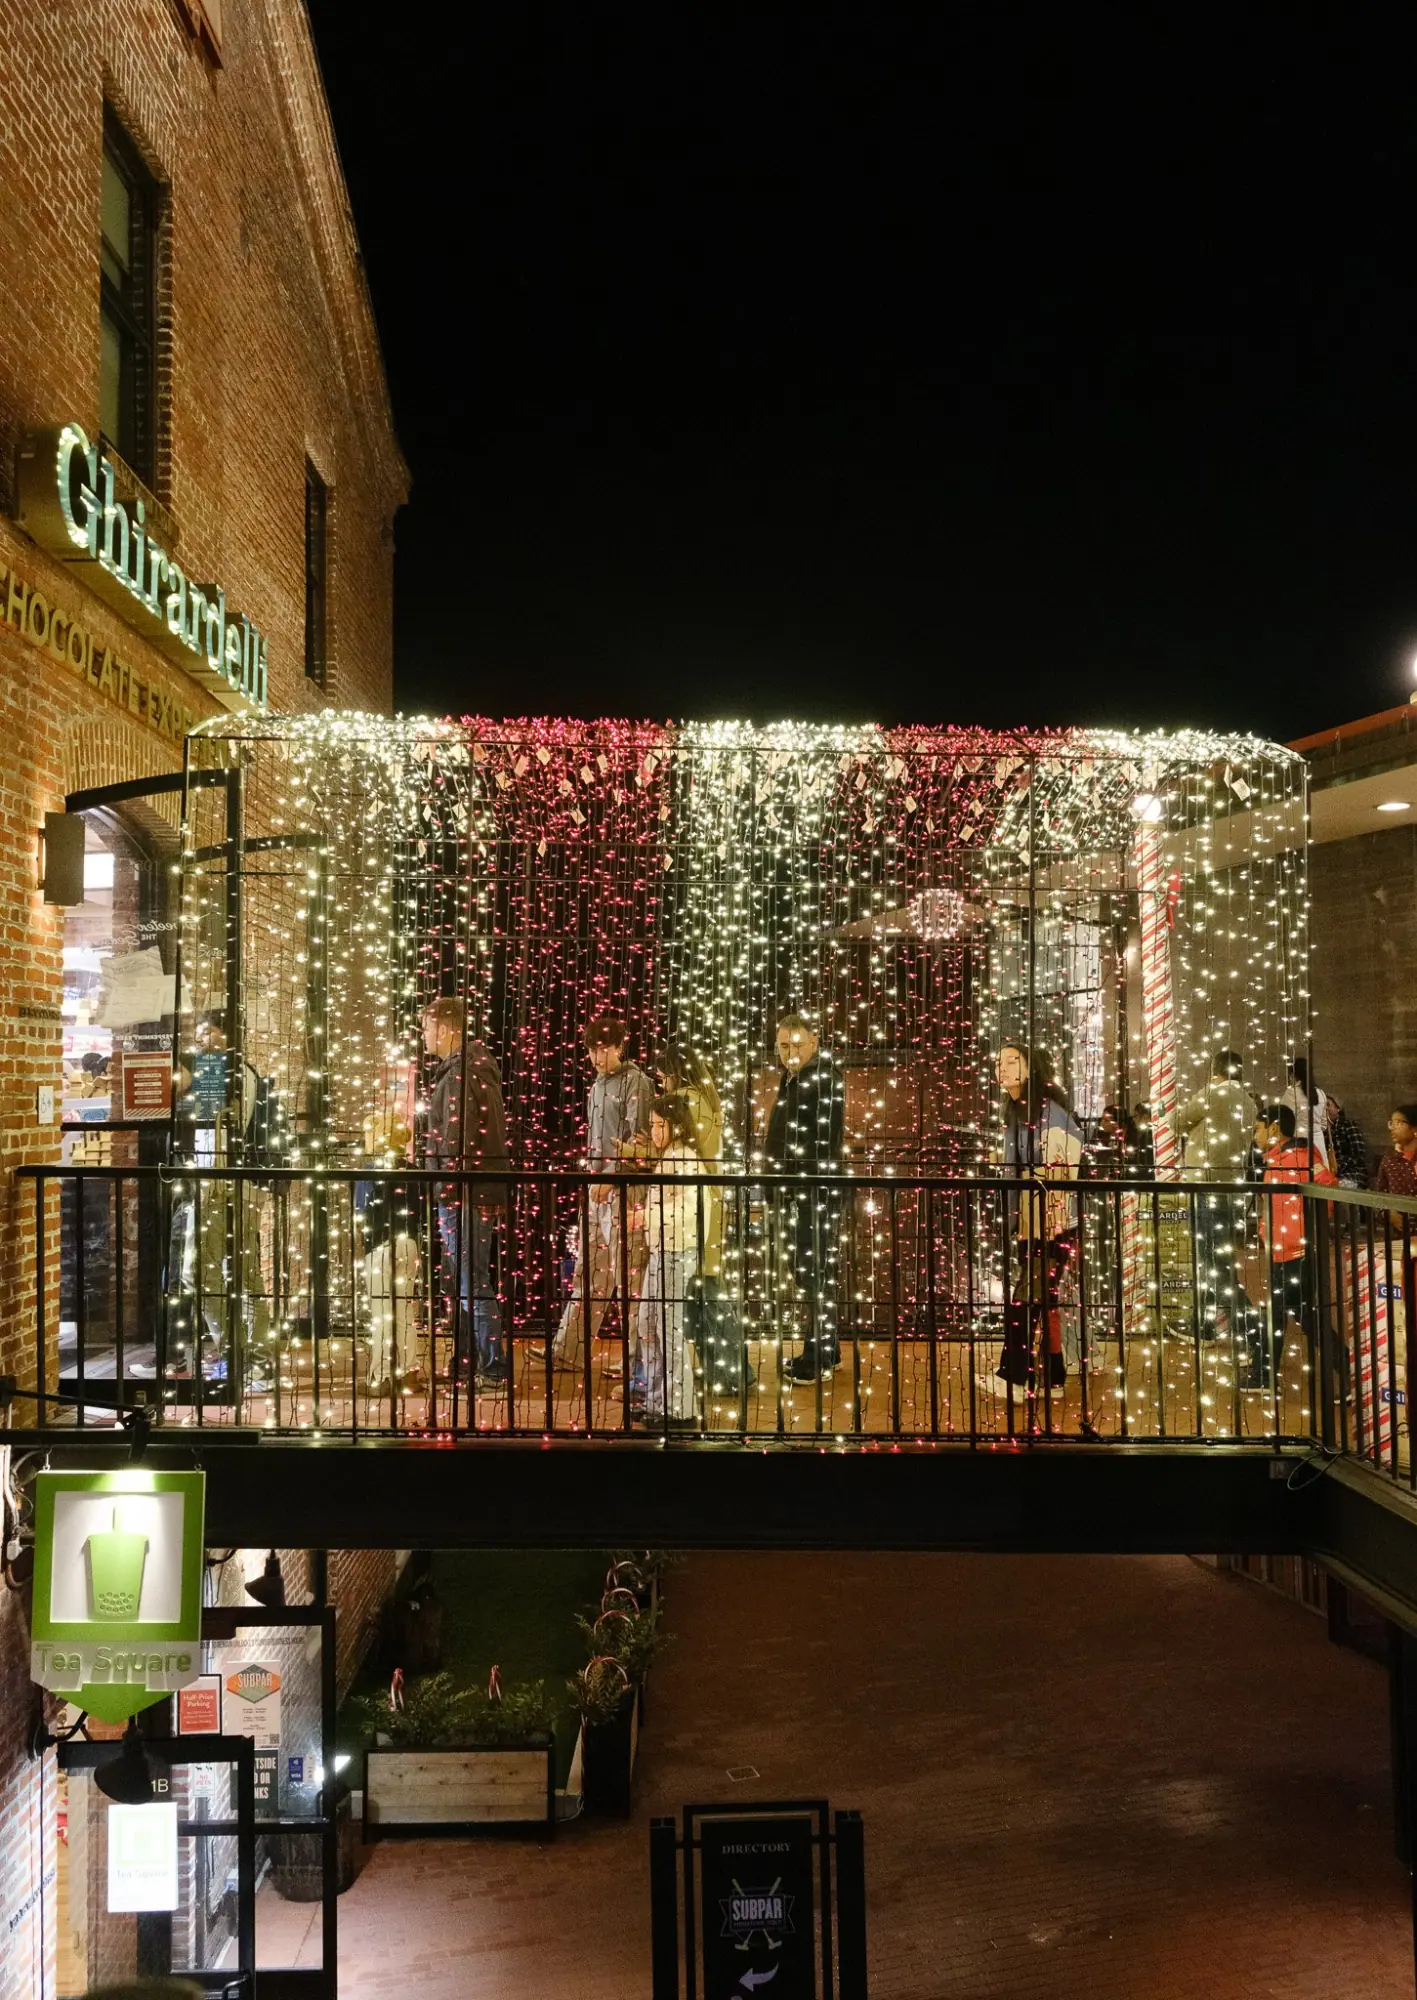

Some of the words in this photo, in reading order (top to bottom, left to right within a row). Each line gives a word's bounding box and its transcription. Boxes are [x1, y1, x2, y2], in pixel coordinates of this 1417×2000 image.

[57, 422, 268, 711] Ghirardelli
[36, 1644, 81, 1672] Tea
[94, 1646, 192, 1678] Square
[237, 1672, 273, 1688] SUBPAR
[187, 1700, 210, 1709] Parking
[255, 1757, 277, 1770] TSIDE
[722, 1843, 791, 1855] DIRECTORY
[732, 1898, 783, 1921] SUBPAR
